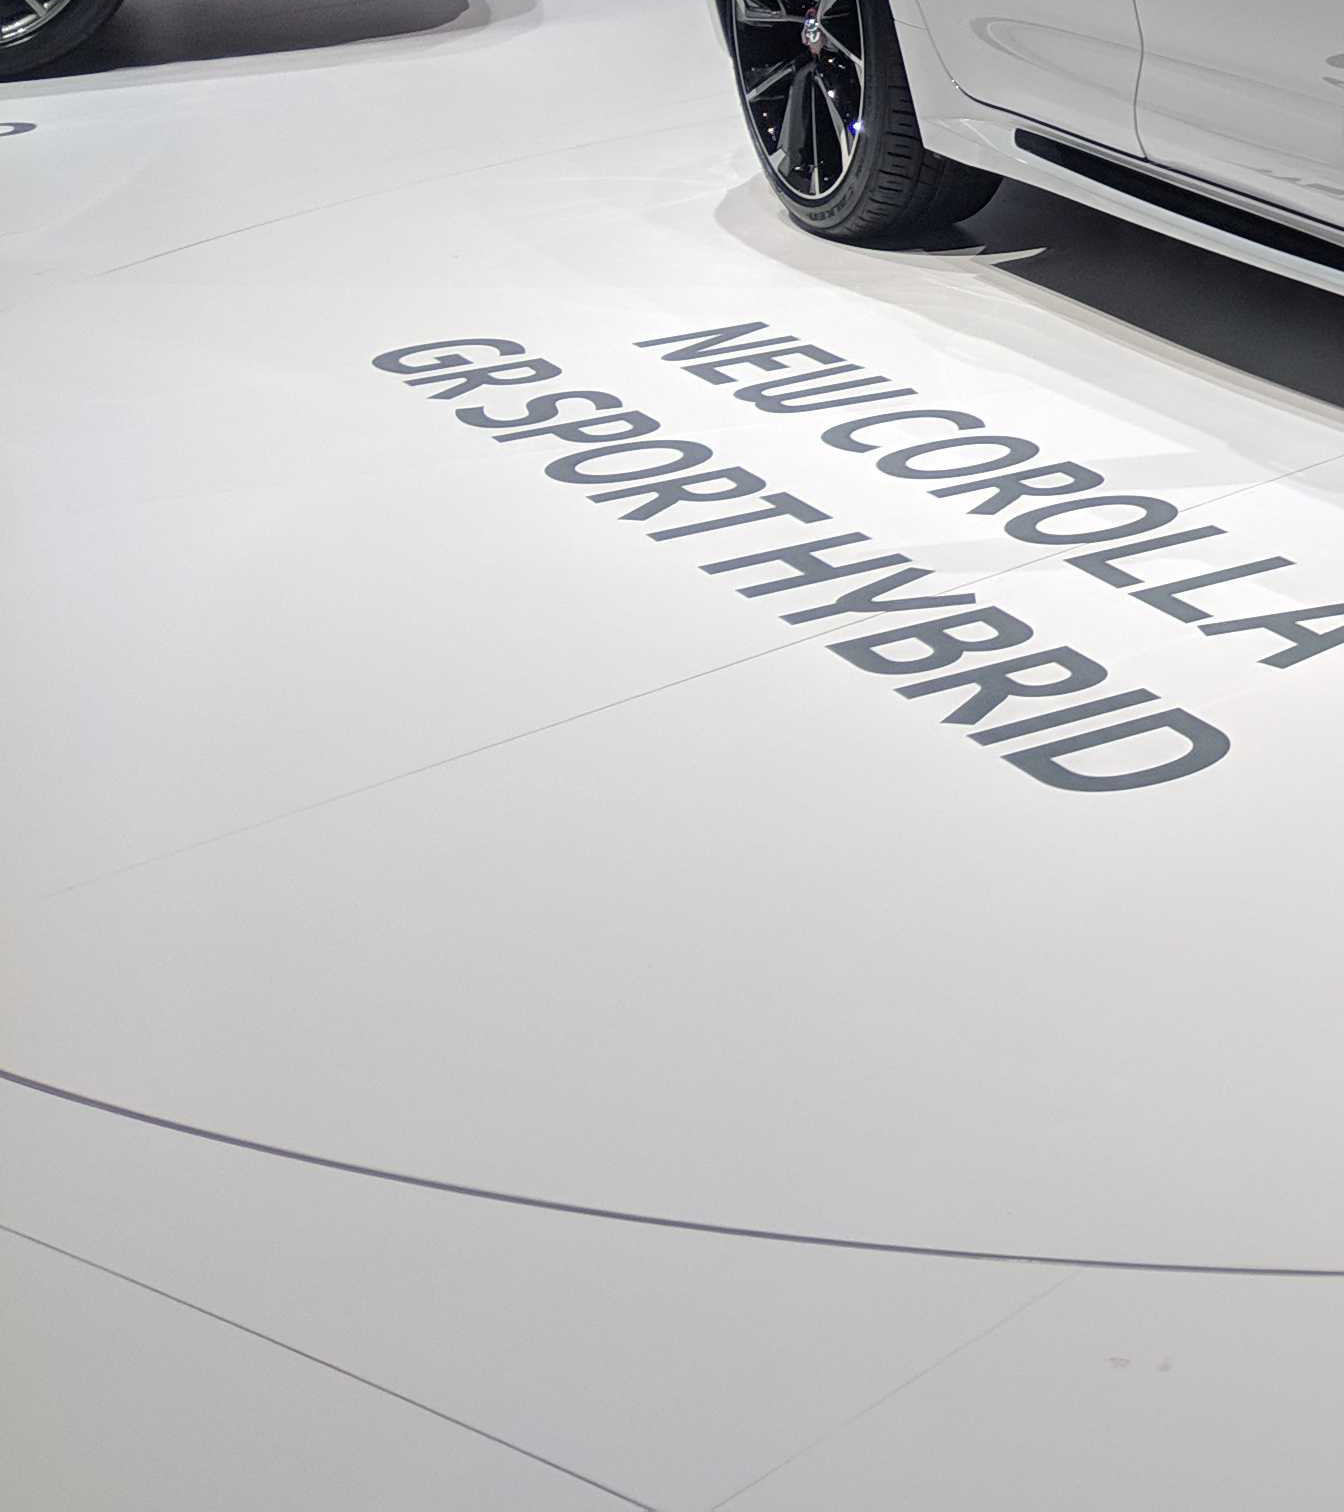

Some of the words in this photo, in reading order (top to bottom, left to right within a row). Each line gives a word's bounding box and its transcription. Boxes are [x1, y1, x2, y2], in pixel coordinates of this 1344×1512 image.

[371, 338, 563, 401] GR
[632, 321, 918, 414] NEW
[454, 390, 833, 543] SPORT
[697, 531, 1231, 793] HYBRID
